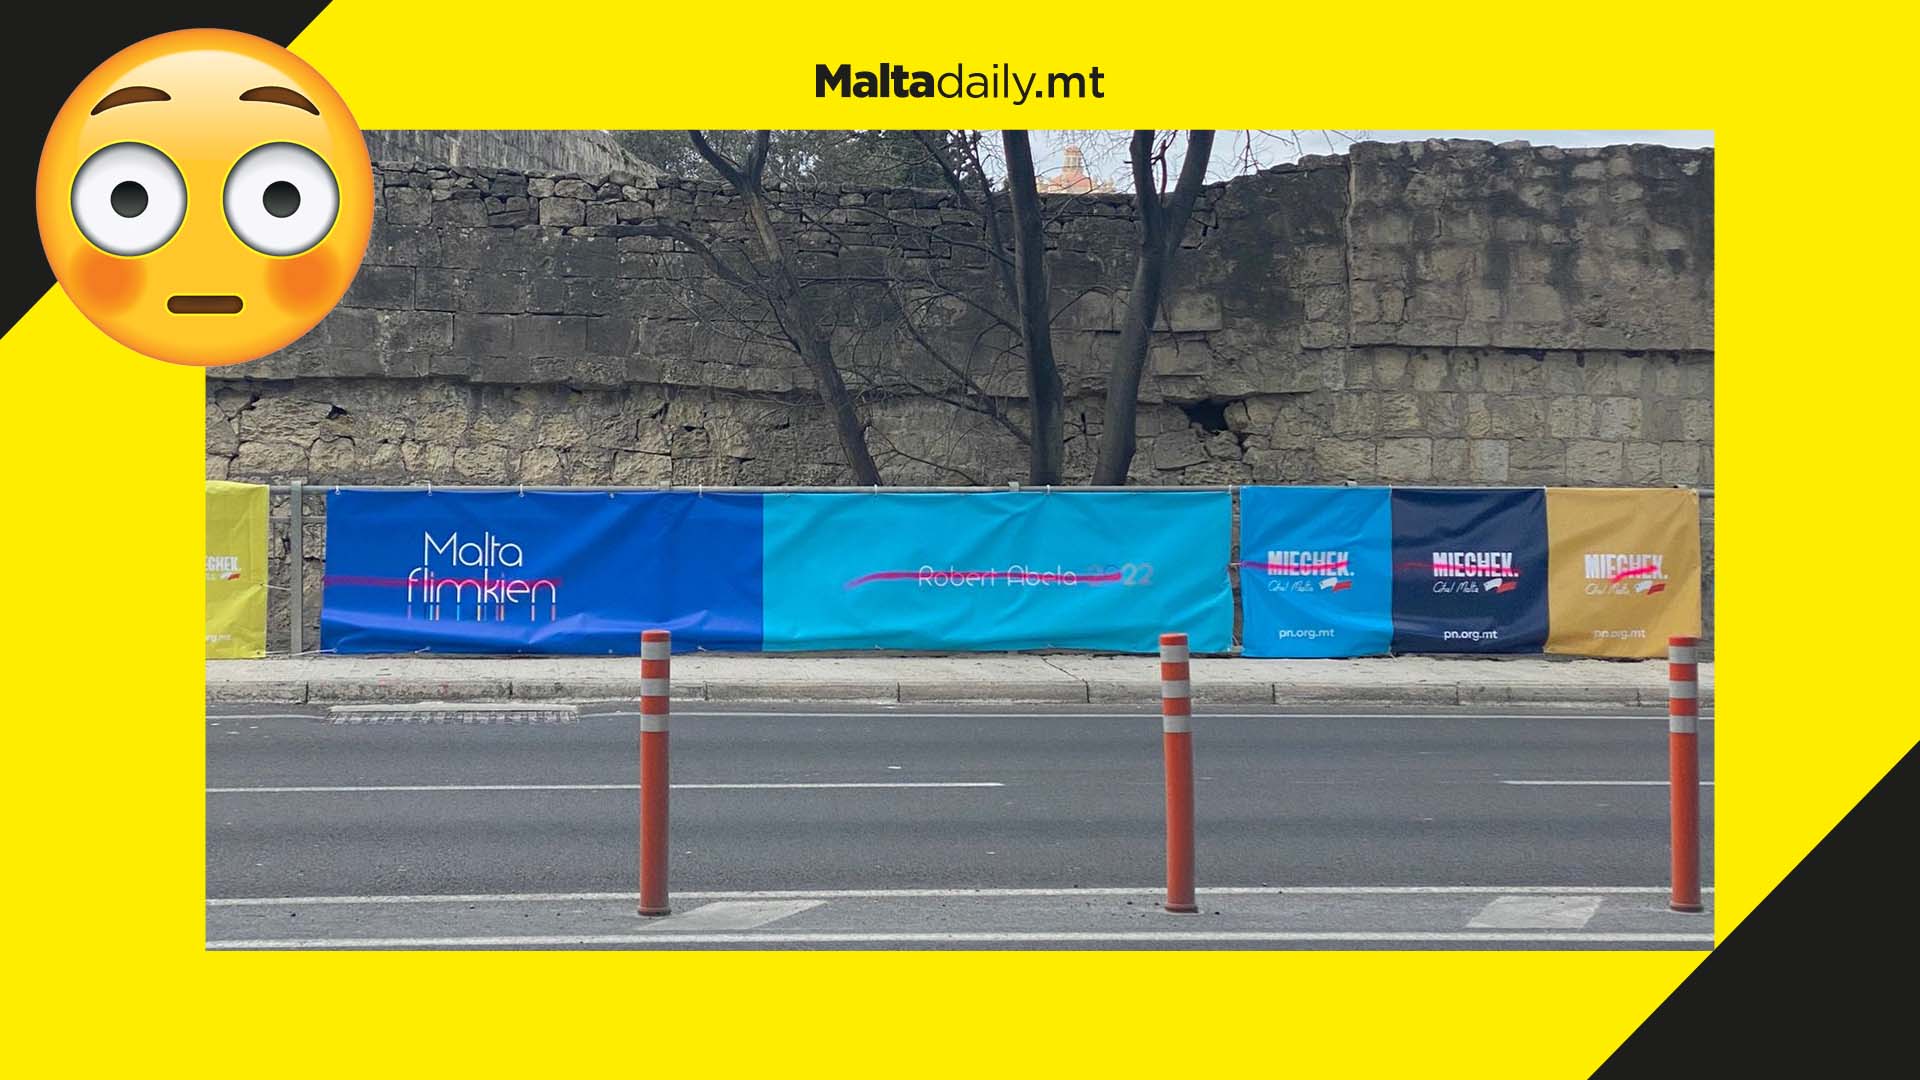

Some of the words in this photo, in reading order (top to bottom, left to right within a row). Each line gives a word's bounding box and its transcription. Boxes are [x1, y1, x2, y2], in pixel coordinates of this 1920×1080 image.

[424, 531, 523, 567] Malta
[408, 567, 557, 604] flimkien
[918, 564, 997, 587] Robert
[1007, 564, 1077, 587] Abela
[1279, 629, 1335, 640] pn.org.mt
[1443, 630, 1498, 641] pn.org.mt
